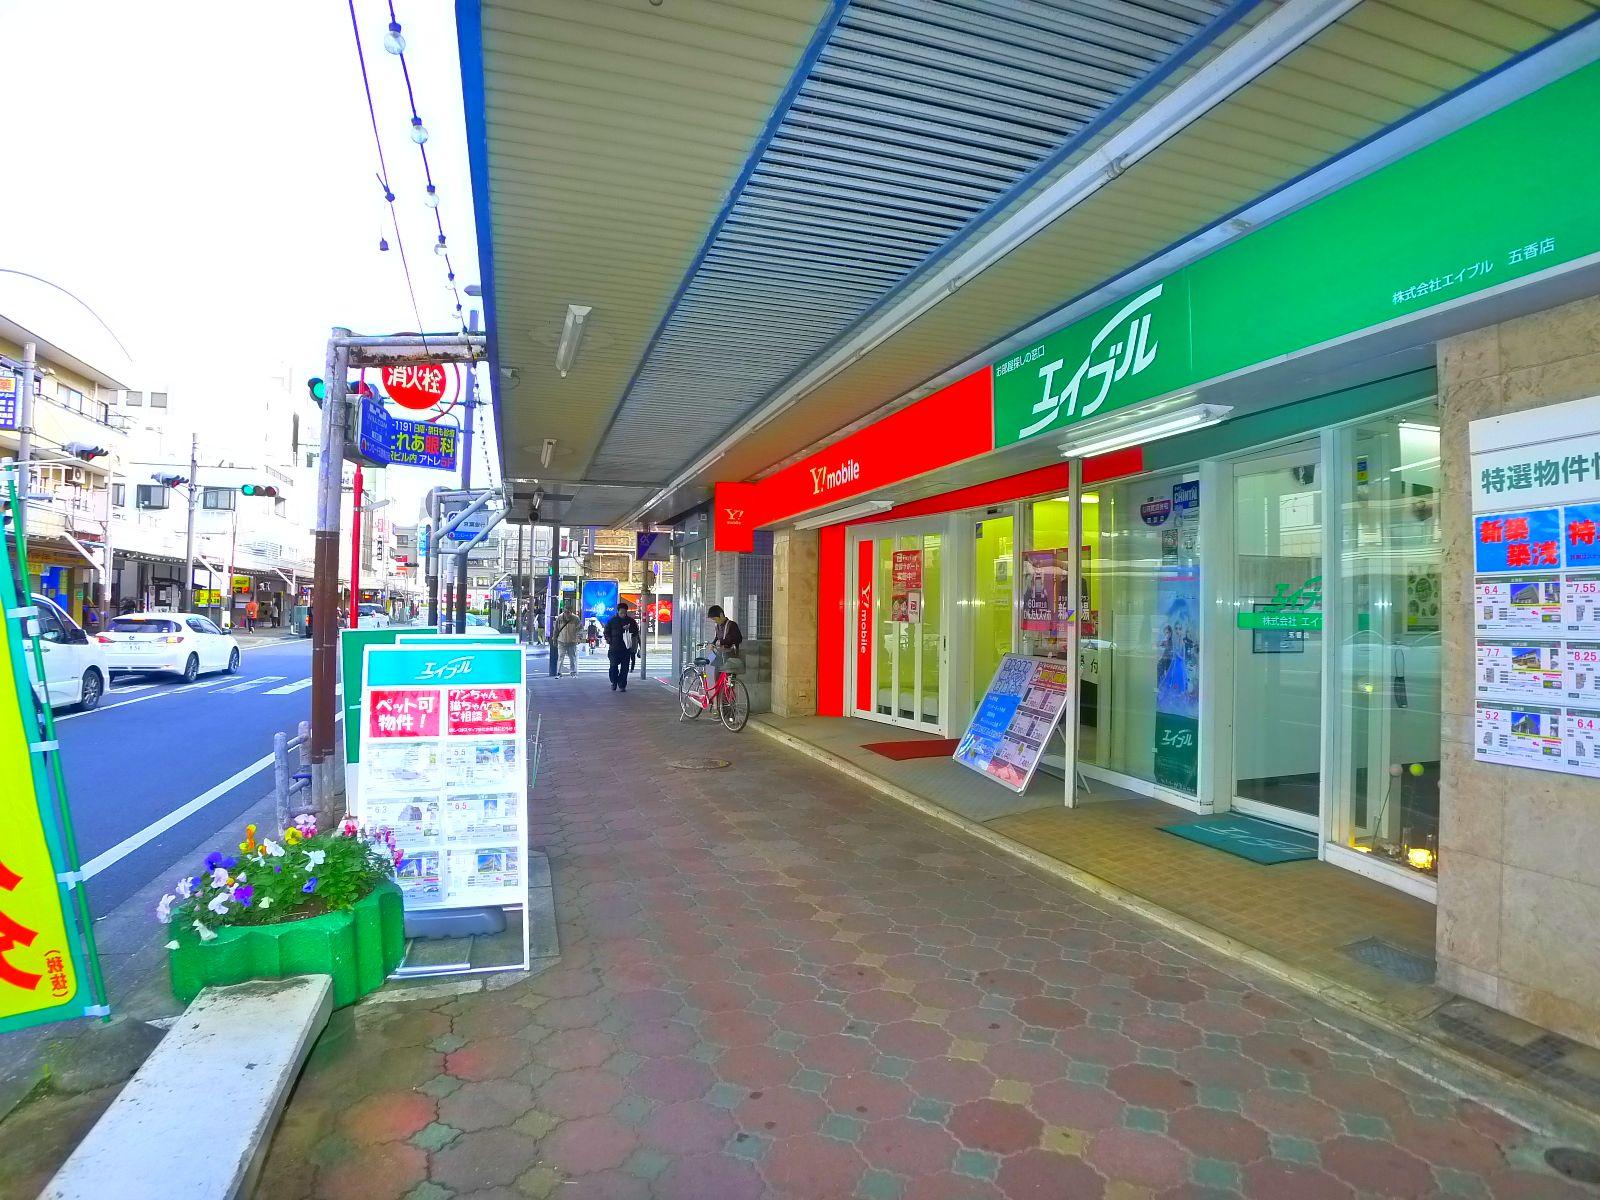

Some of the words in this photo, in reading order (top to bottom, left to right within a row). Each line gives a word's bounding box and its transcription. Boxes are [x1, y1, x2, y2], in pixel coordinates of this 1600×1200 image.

[1392, 260, 1494, 305] 株式会社エイブル
[1507, 237, 1556, 265] 五香店
[996, 344, 1045, 377] お部屋探しの窓口
[1018, 284, 1164, 440] エイブル
[387, 365, 442, 394] 消火栓
[390, 432, 455, 457] れあ眼科
[809, 459, 860, 495] Y!mobile
[1480, 516, 1530, 543] 新築
[1568, 519, 1600, 546] 特
[1573, 583, 1597, 593] 7.55
[860, 582, 872, 654] Y!mobile
[1262, 616, 1297, 626] 株式会社
[1301, 617, 1322, 627] エイ
[414, 655, 475, 680] エイブル
[376, 696, 435, 714] ペット可
[450, 689, 498, 700] ワンちゃん
